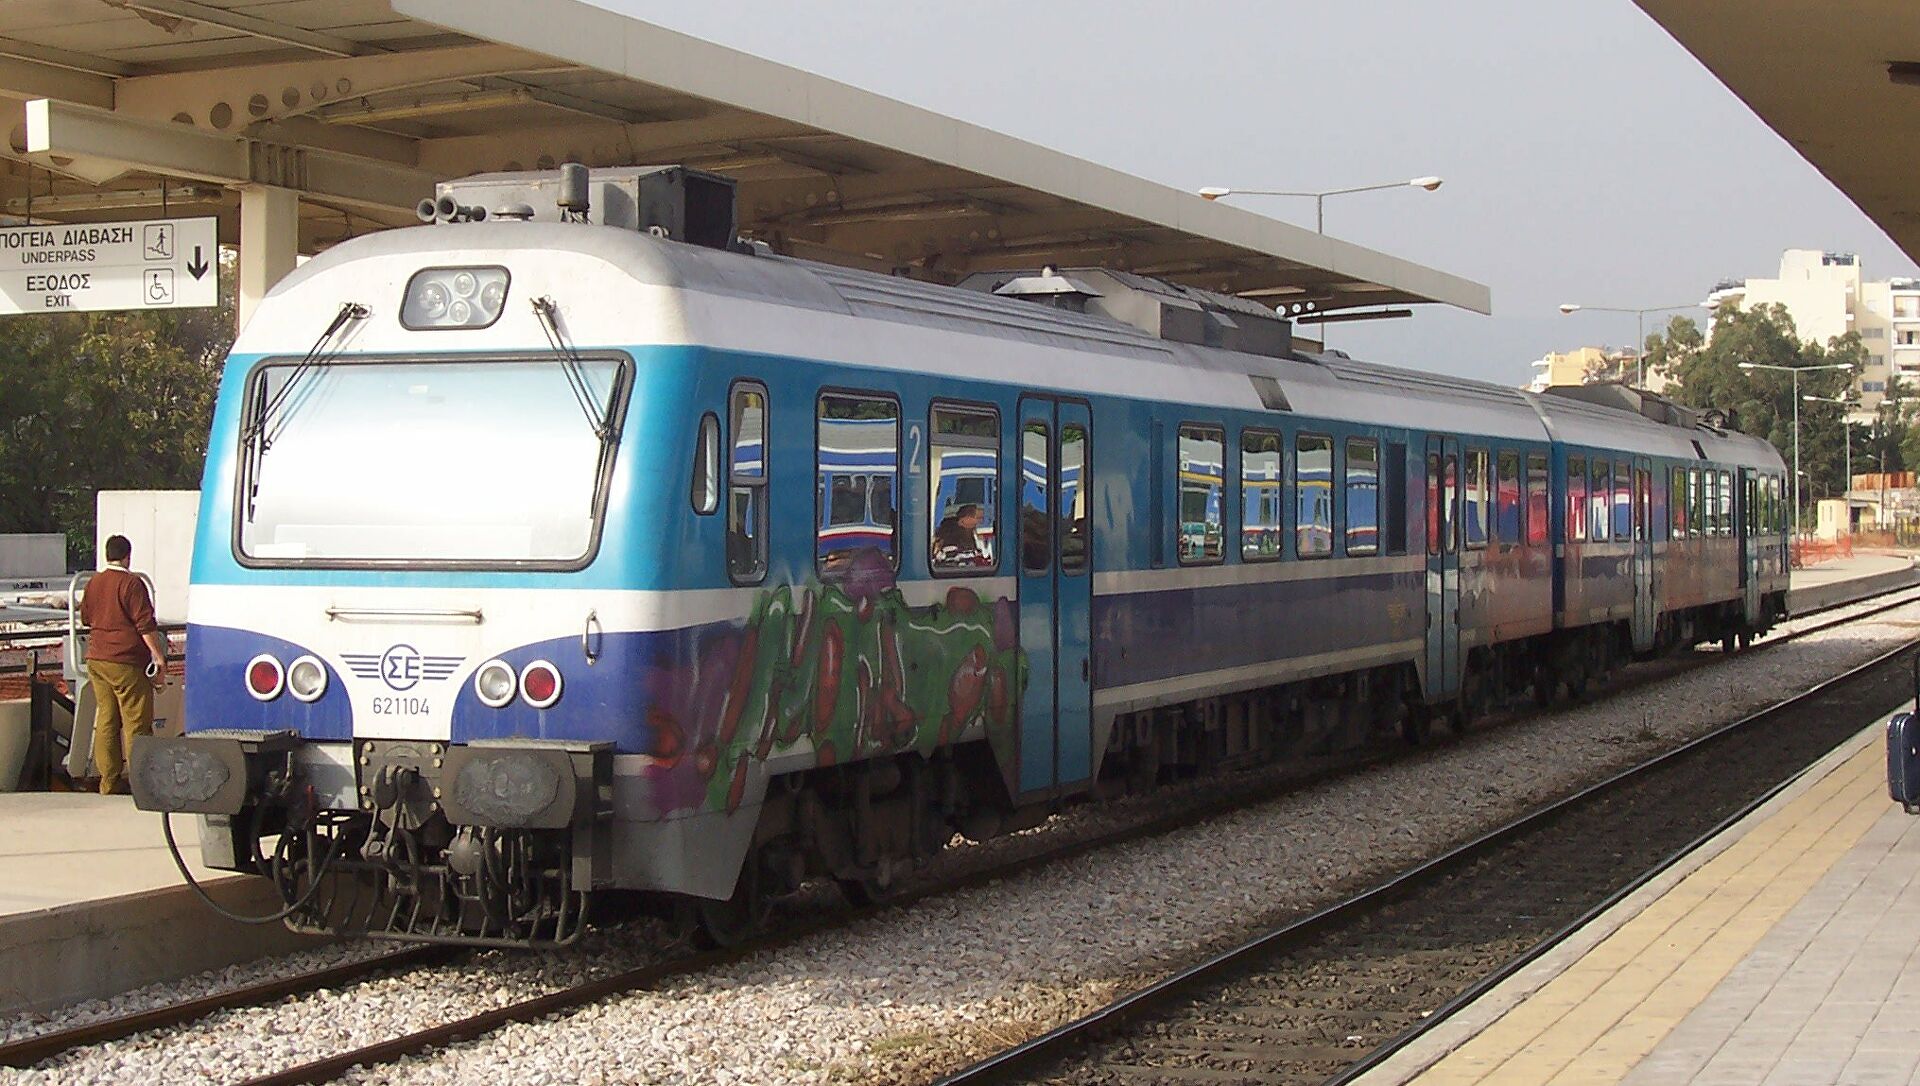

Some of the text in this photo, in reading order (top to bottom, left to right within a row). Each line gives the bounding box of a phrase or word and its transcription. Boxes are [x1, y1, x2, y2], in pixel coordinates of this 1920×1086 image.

[63, 226, 133, 246] ΔΙΑΒΑΣΗ
[22, 249, 96, 264] UNDERPASS
[26, 273, 91, 291] ΕΞΟΔΟΣ
[45, 295, 72, 308] EXIT
[909, 425, 921, 473] 2
[373, 697, 430, 715] 621104
